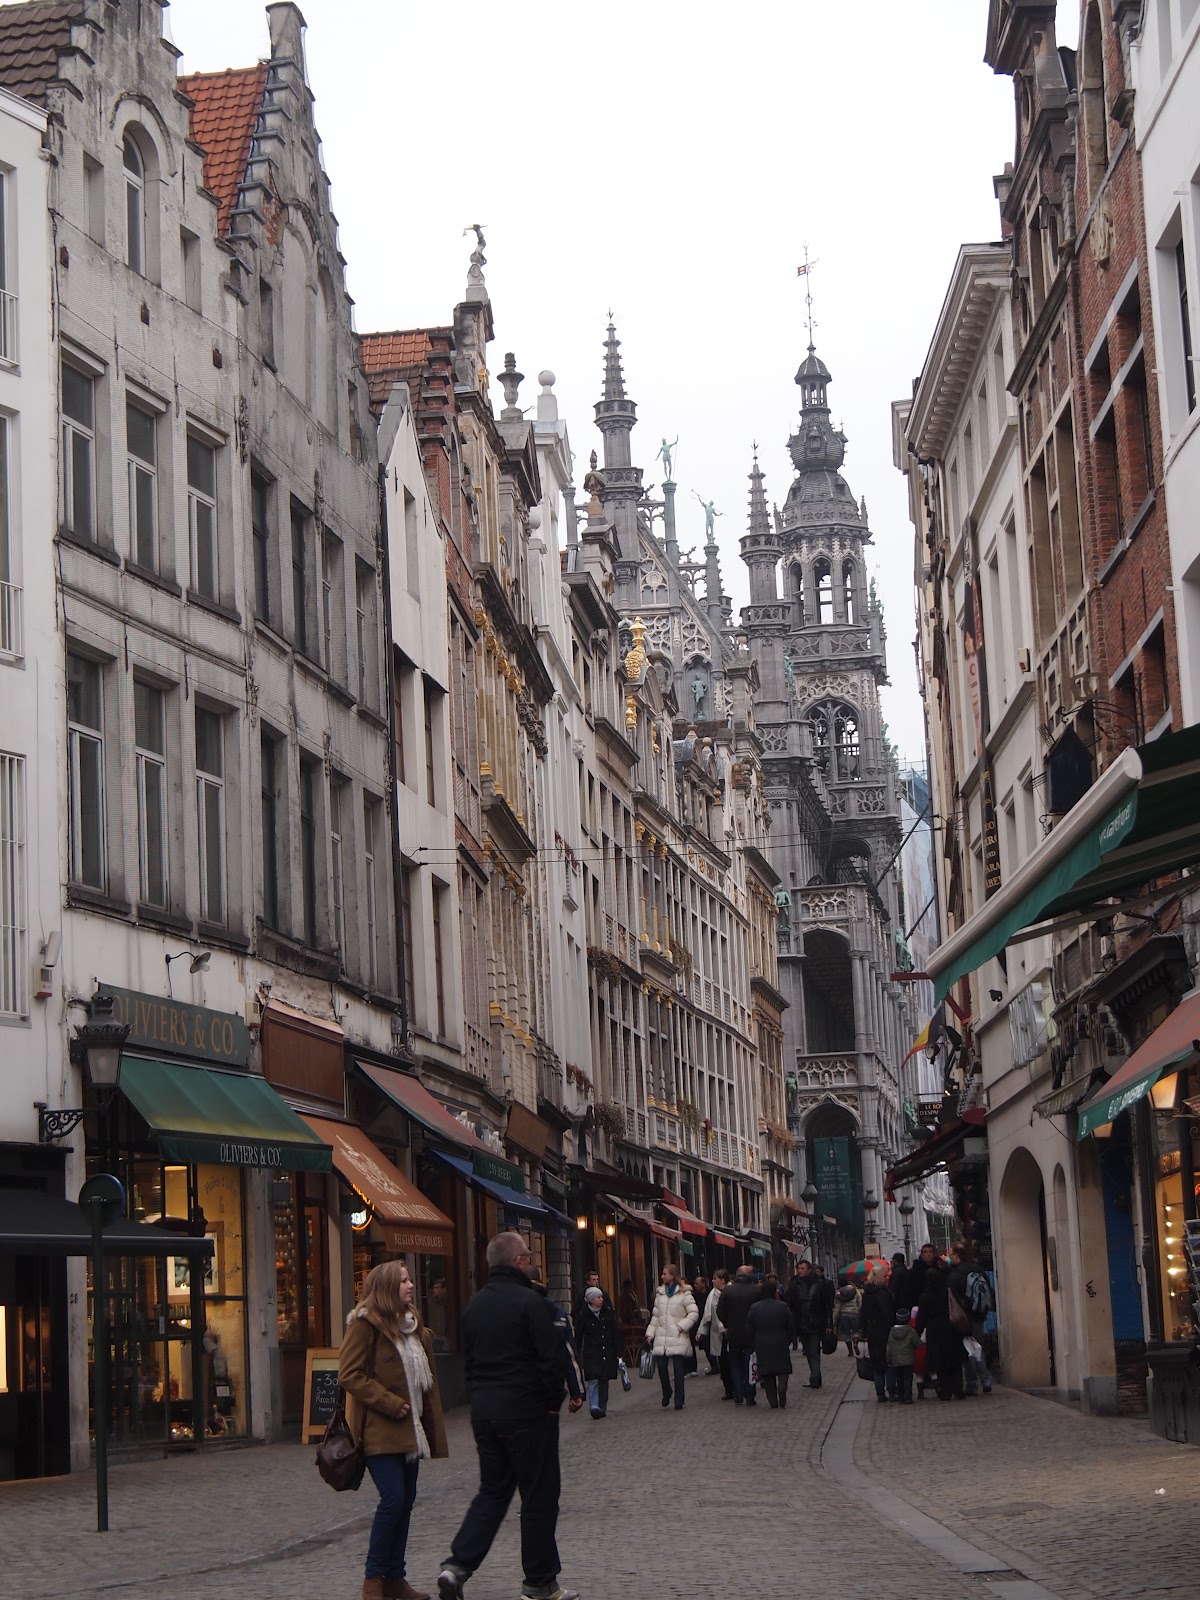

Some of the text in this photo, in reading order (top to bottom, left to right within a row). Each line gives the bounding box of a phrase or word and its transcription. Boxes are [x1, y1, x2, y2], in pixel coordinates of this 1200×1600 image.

[111, 994, 238, 1056] OLIVIERS & CO.
[220, 1143, 258, 1165] OLIVIERS
[260, 1146, 267, 1166] &
[394, 1233, 443, 1248] BELGIAN CHOCOLATES
